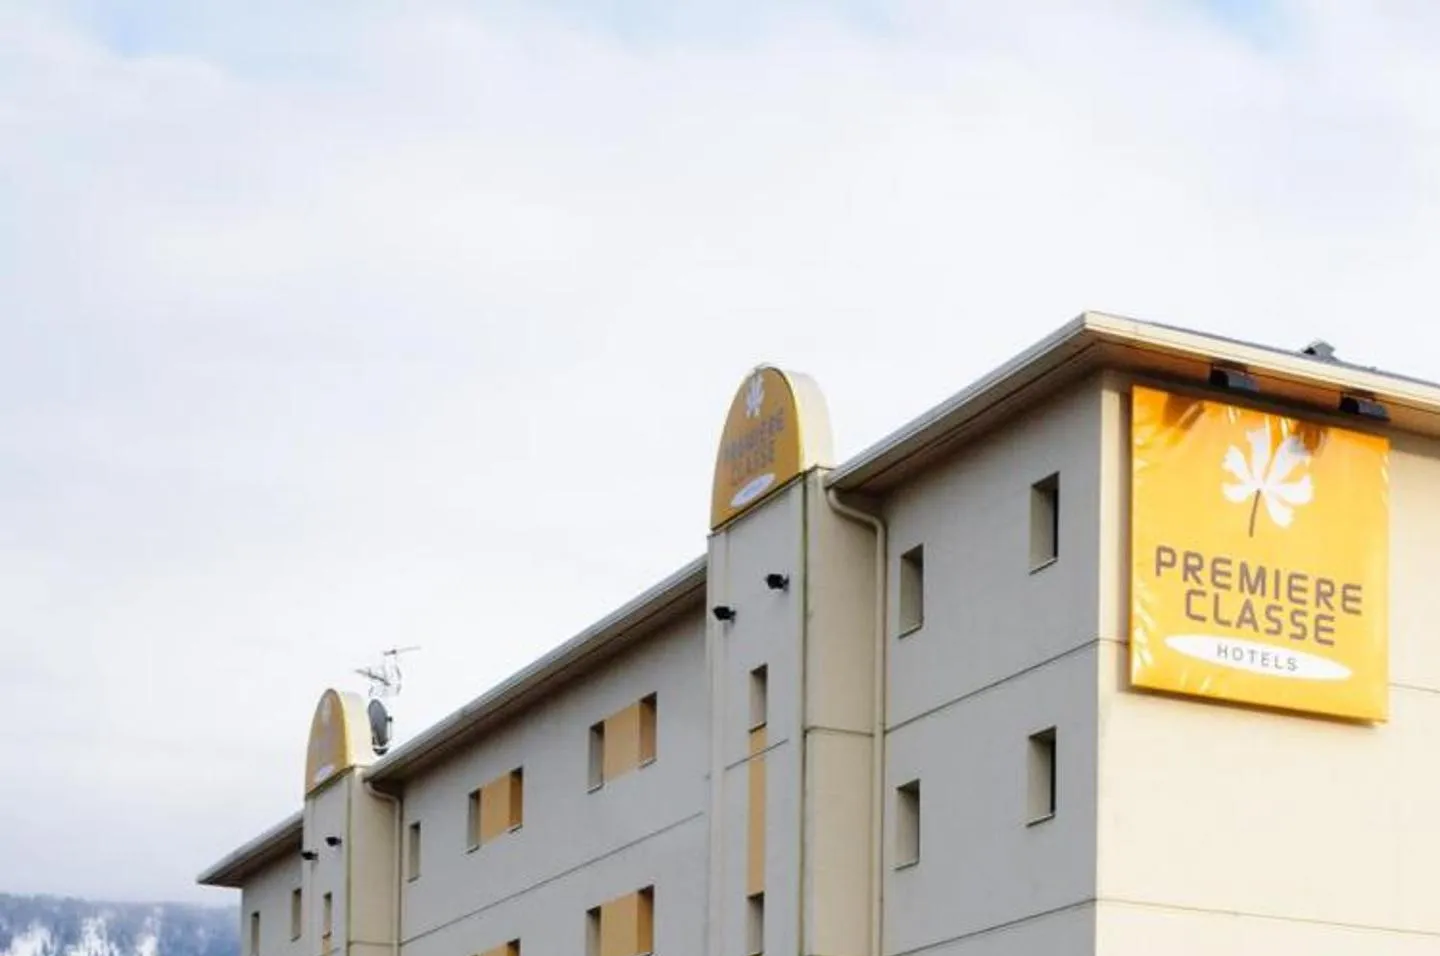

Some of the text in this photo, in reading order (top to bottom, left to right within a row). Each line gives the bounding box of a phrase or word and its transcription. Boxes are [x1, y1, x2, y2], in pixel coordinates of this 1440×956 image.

[1155, 545, 1363, 616] PREMIERE
[1185, 588, 1336, 647] CLASSE
[1216, 643, 1299, 672] HOTELS
